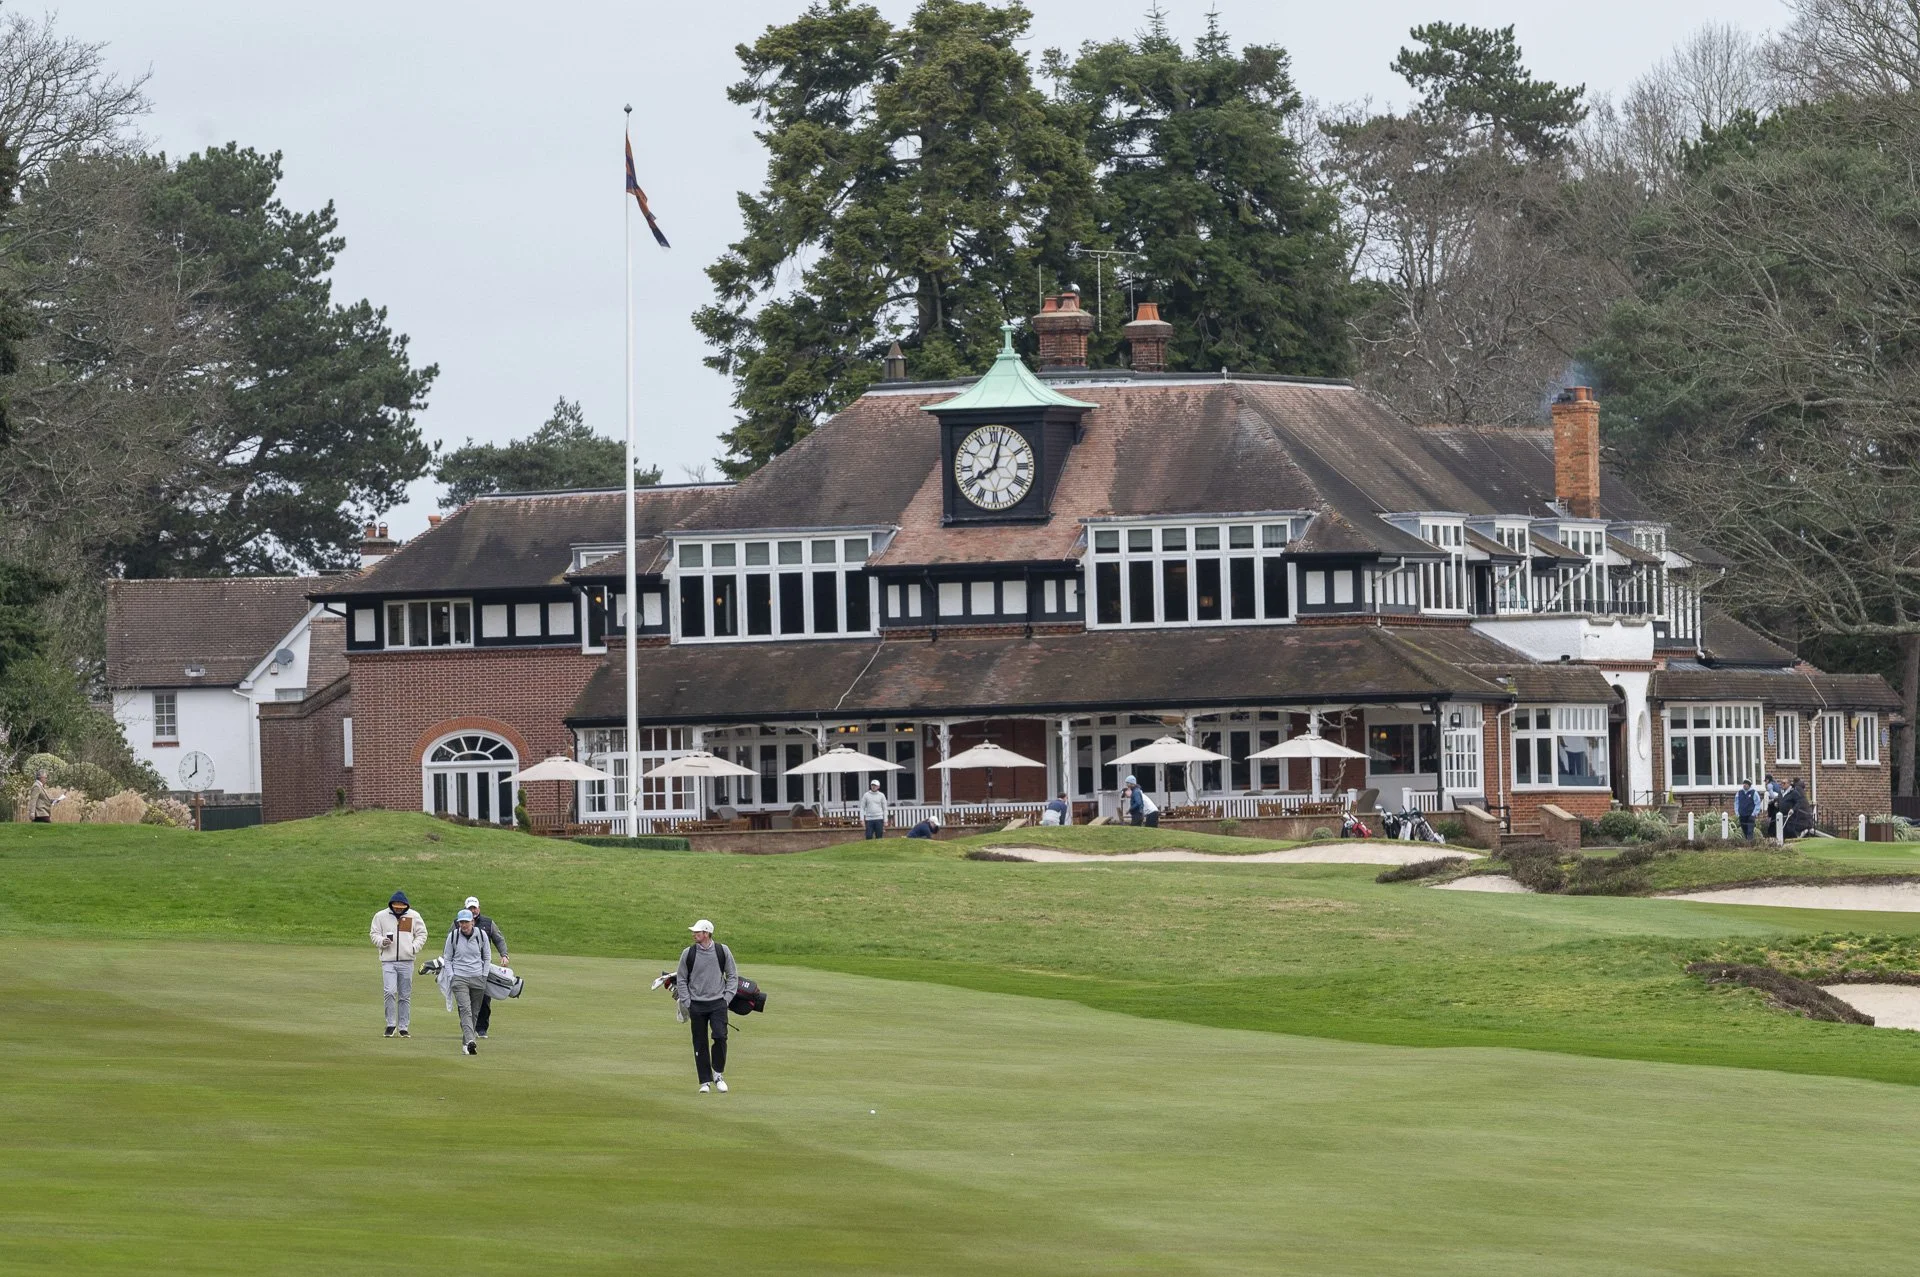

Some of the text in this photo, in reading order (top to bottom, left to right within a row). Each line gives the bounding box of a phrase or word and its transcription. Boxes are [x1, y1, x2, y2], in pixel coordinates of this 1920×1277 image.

[990, 431, 998, 442] XII
[1005, 436, 1011, 446] I
[1014, 447, 1024, 456] II
[1013, 475, 1026, 487] IIII
